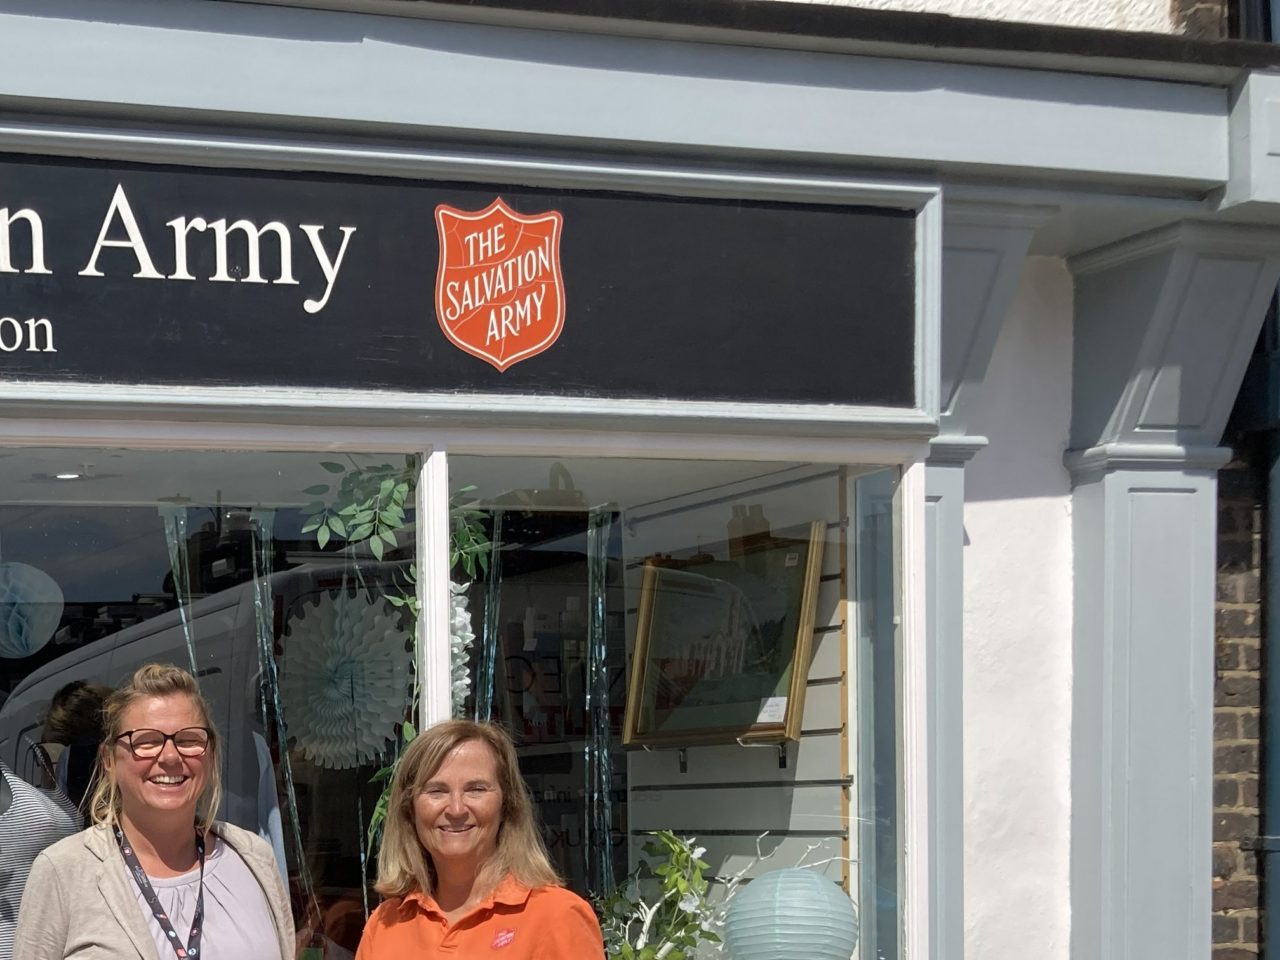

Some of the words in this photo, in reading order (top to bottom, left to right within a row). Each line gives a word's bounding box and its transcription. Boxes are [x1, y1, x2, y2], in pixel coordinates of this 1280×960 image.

[77, 183, 357, 314] Army
[445, 236, 551, 320] SALVATION
[464, 223, 506, 267] THE
[485, 284, 546, 346] ARMY
